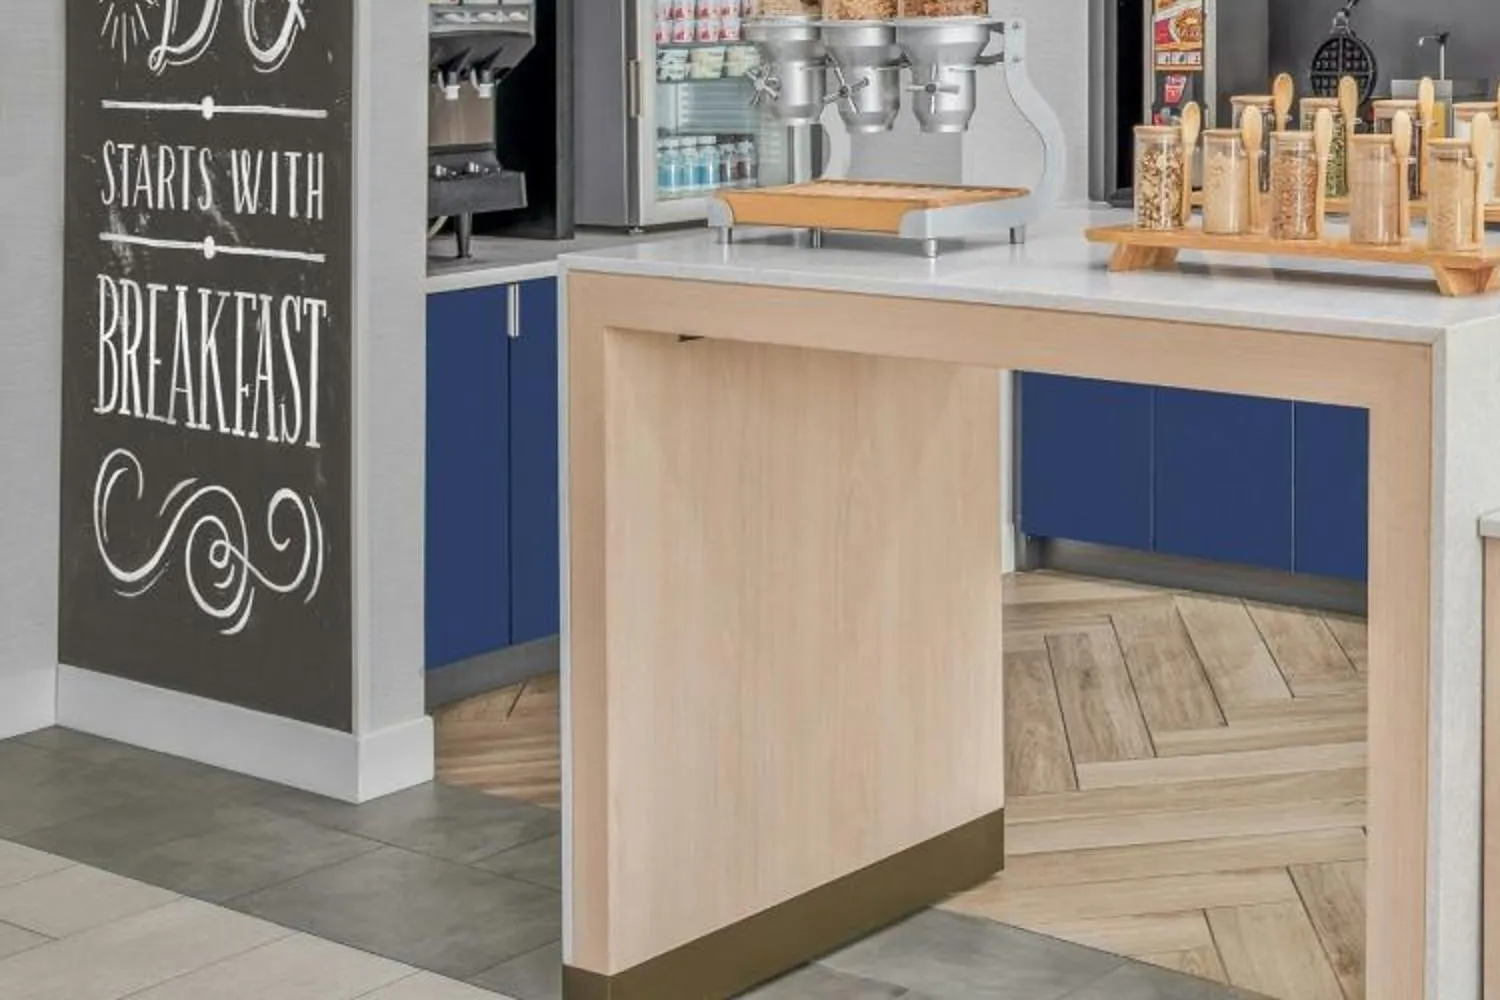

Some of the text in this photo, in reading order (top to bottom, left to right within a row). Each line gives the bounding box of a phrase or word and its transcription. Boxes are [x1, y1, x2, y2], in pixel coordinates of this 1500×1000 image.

[101, 138, 323, 221] STARTS WITH
[93, 272, 328, 449] BREAKFAST
